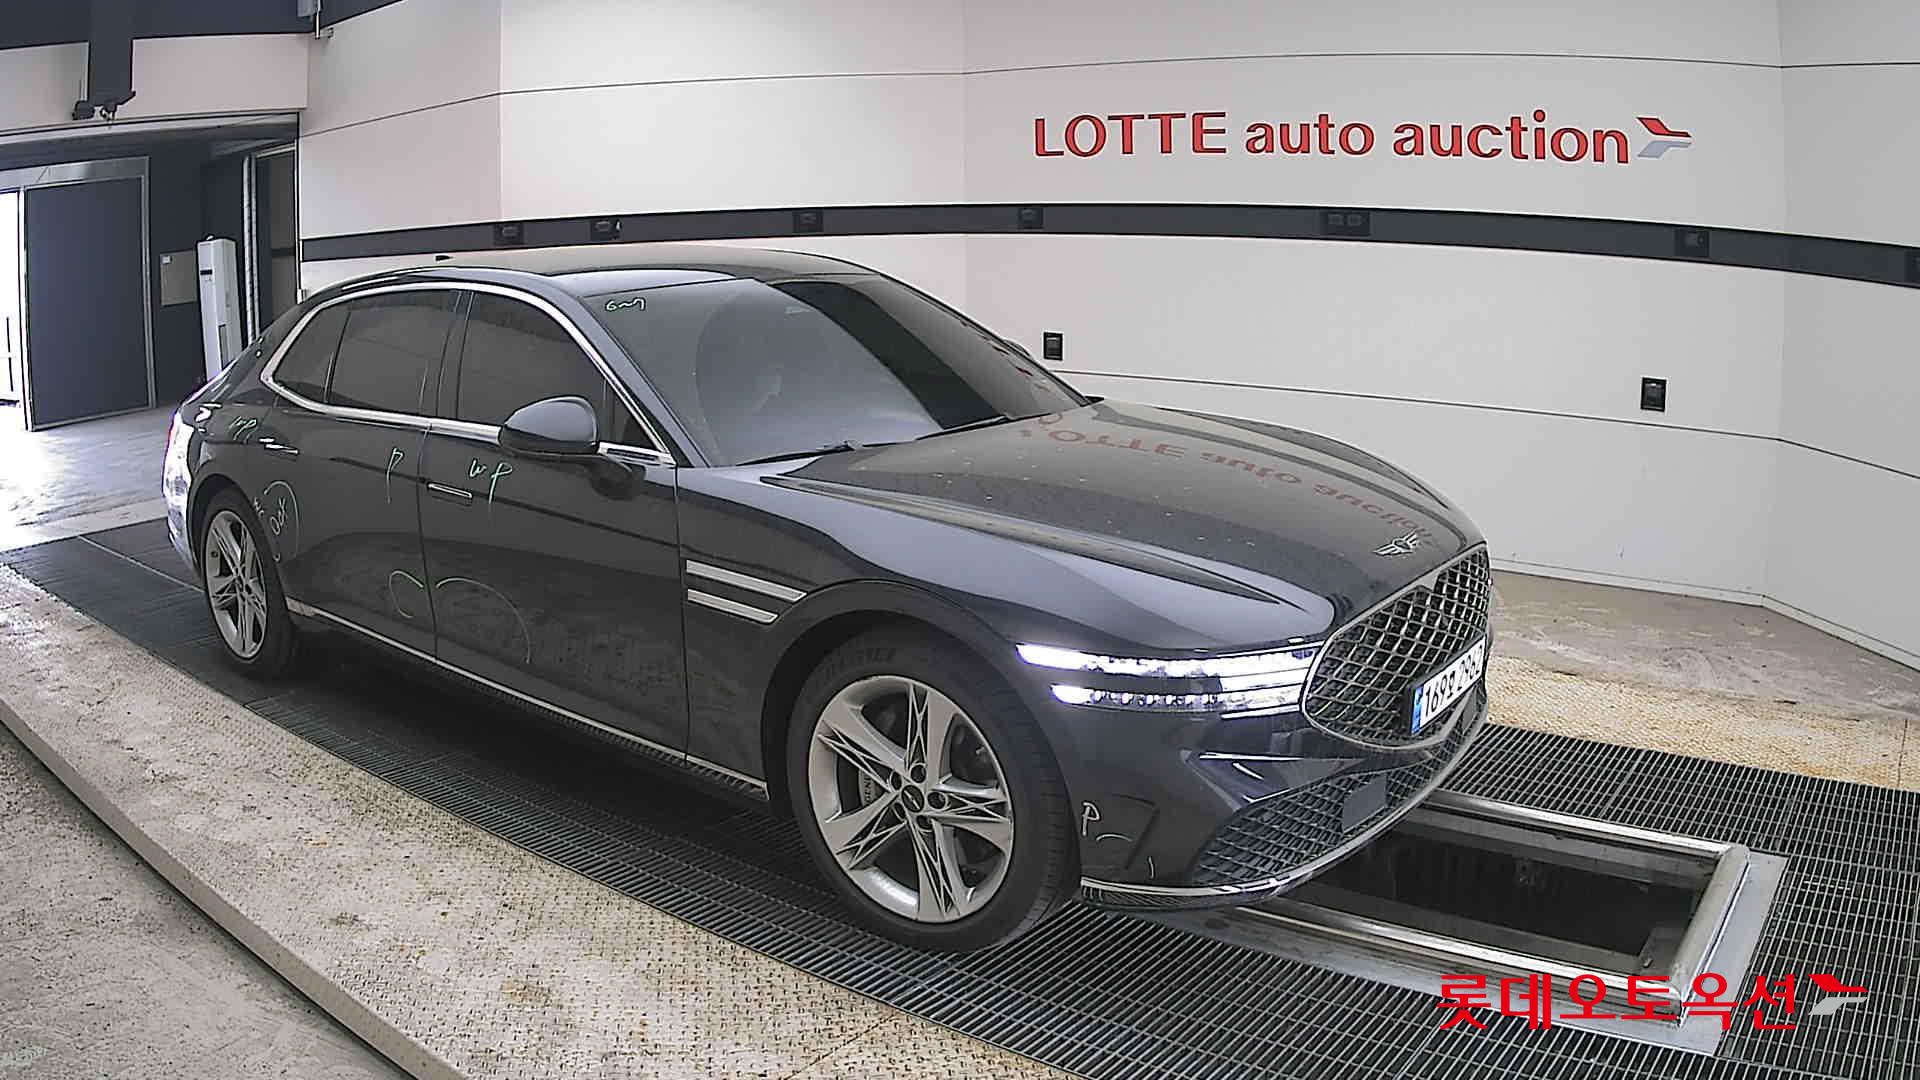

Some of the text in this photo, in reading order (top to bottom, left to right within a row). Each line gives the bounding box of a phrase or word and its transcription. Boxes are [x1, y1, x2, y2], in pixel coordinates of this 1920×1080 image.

[1034, 109, 1630, 165] LOTTE auto auction
